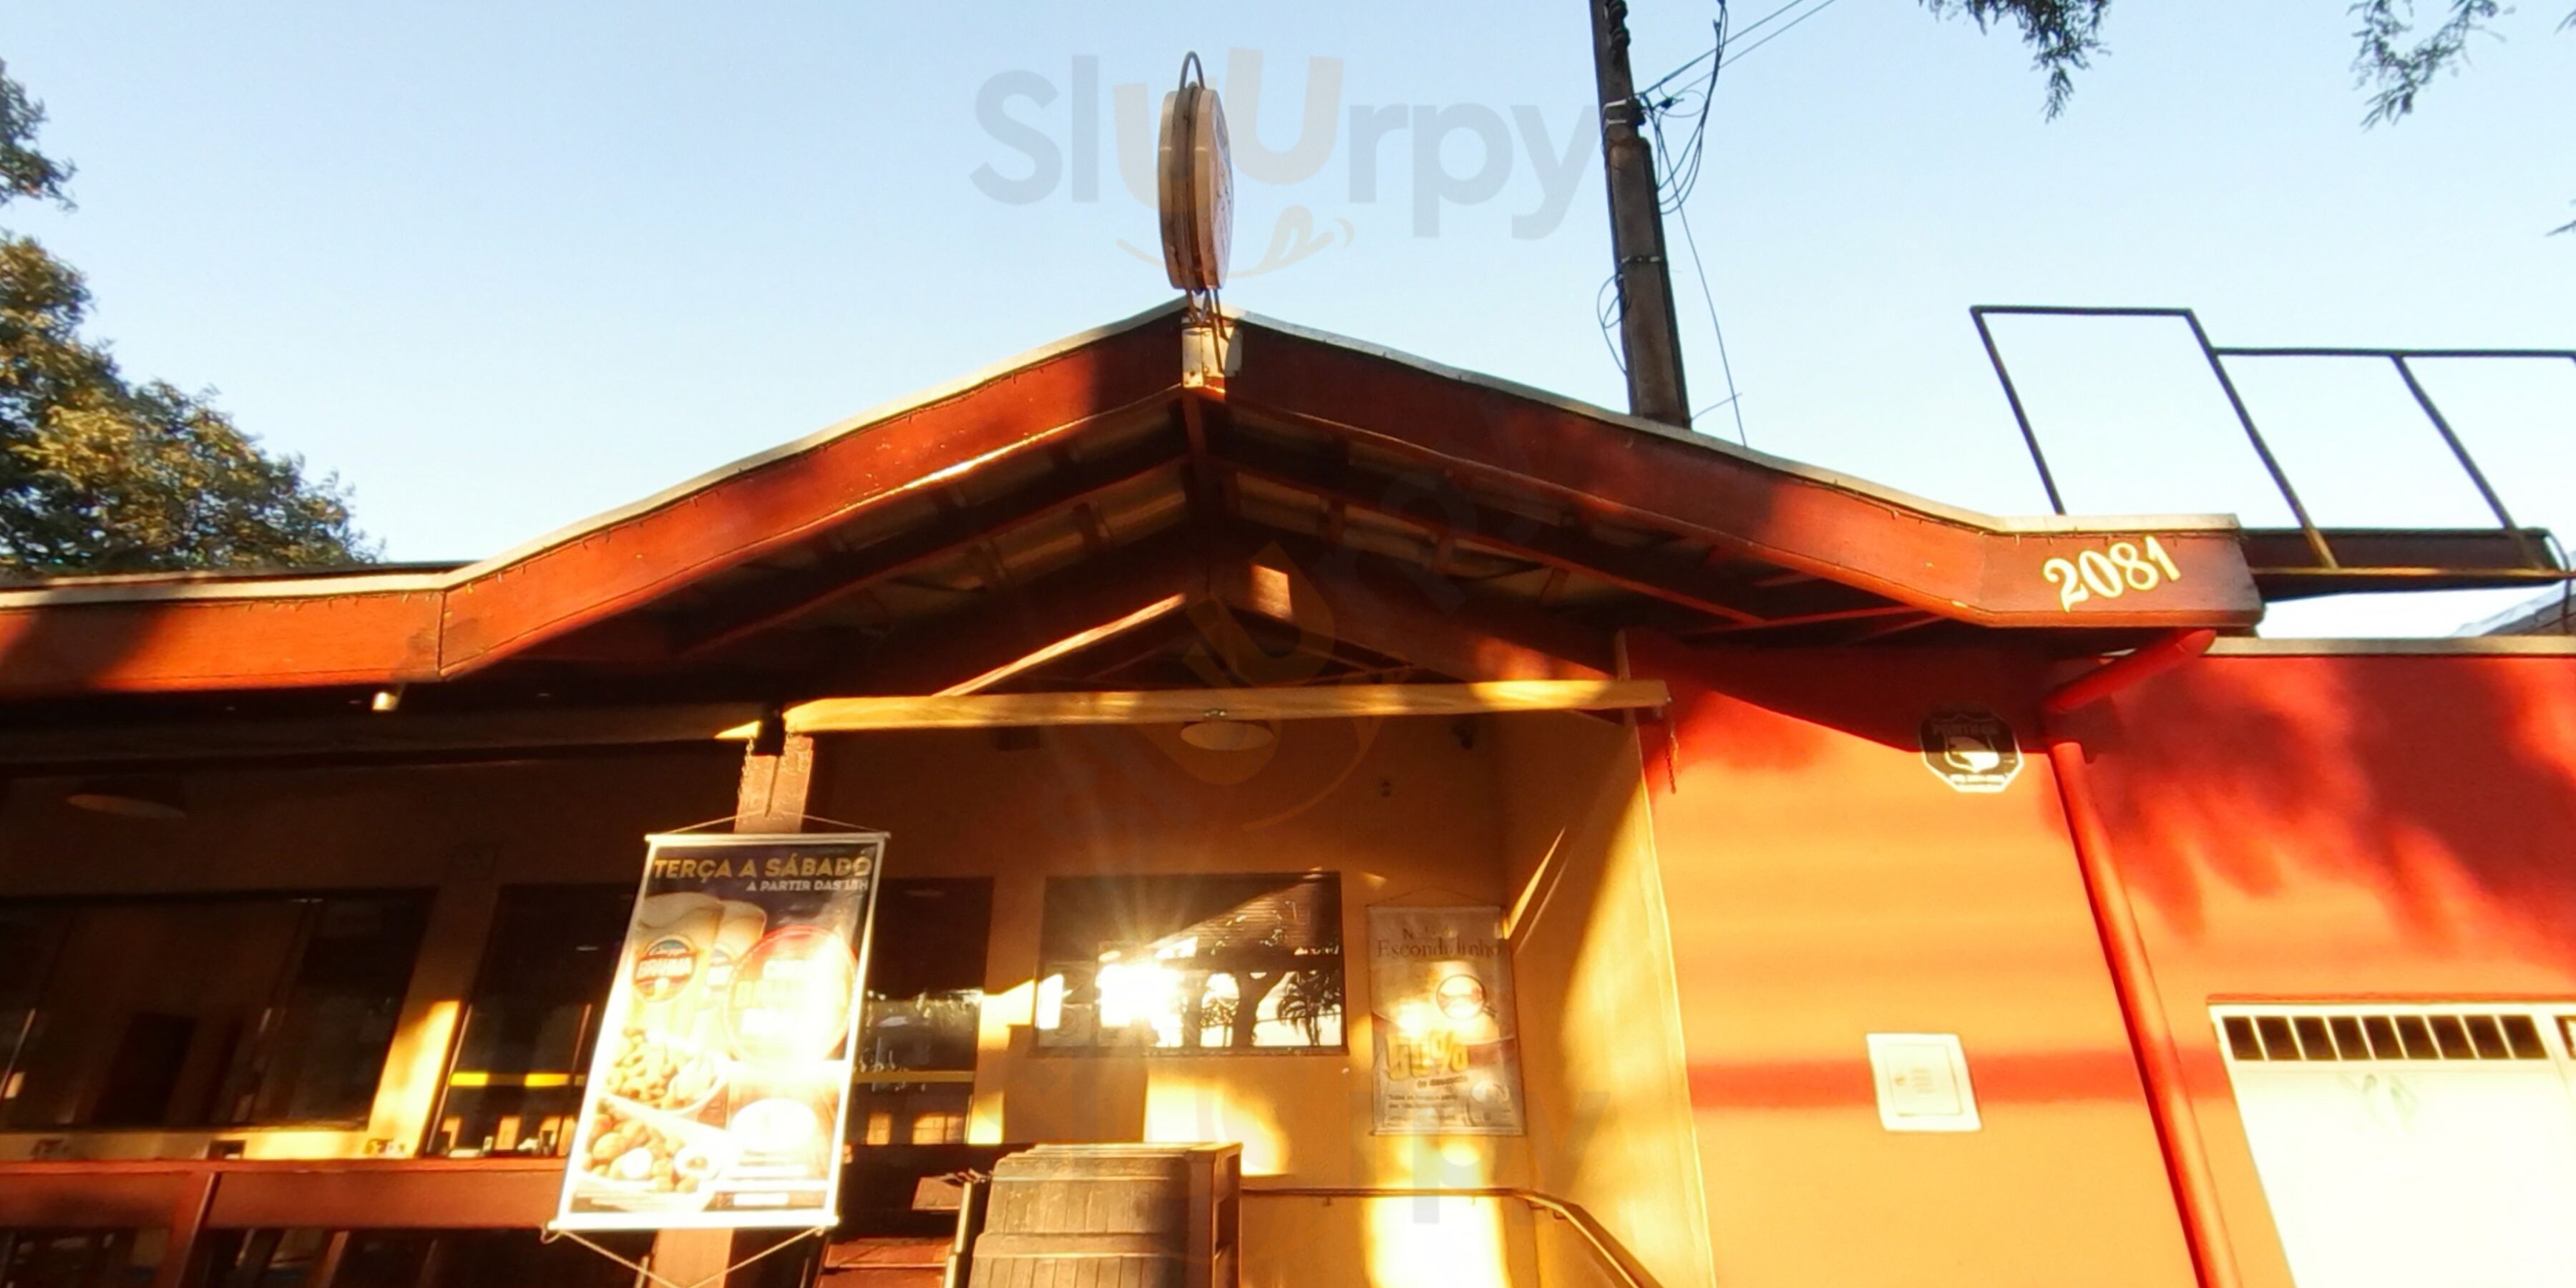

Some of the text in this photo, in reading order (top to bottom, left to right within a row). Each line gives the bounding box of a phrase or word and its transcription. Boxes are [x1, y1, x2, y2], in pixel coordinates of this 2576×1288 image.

[2043, 535, 2181, 613] 2081
[654, 853, 872, 883] TERÇA A SÁBADO
[746, 880, 756, 891] A
[760, 880, 811, 891] PARTIR
